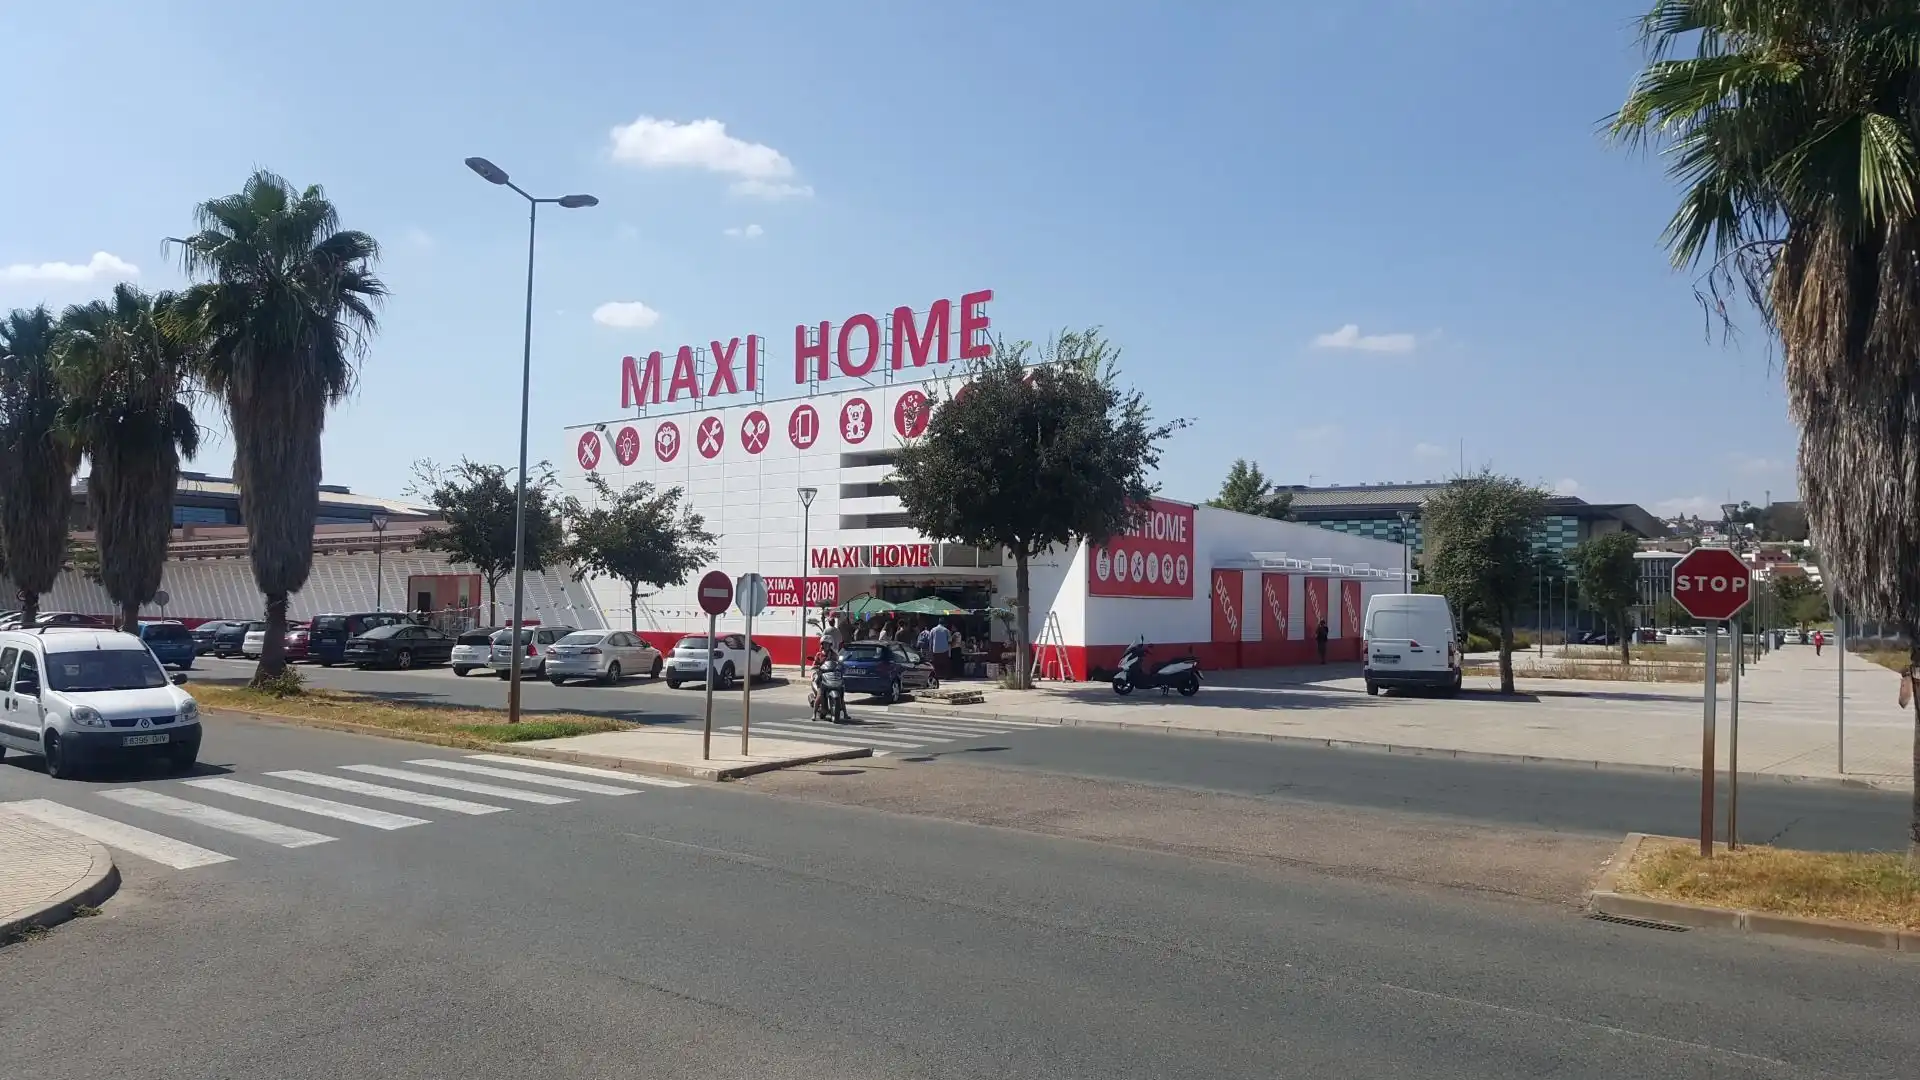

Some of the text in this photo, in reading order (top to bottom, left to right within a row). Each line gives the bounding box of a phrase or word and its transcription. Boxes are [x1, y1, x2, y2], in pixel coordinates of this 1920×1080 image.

[621, 289, 994, 408] MAXI HOME
[1144, 511, 1187, 543] HOME
[811, 544, 931, 569] MAXI HOME
[805, 581, 835, 602] 28/09
[1676, 575, 1746, 592] STOP
[1215, 575, 1238, 636] DECOR
[1265, 578, 1286, 636] HOGAR
